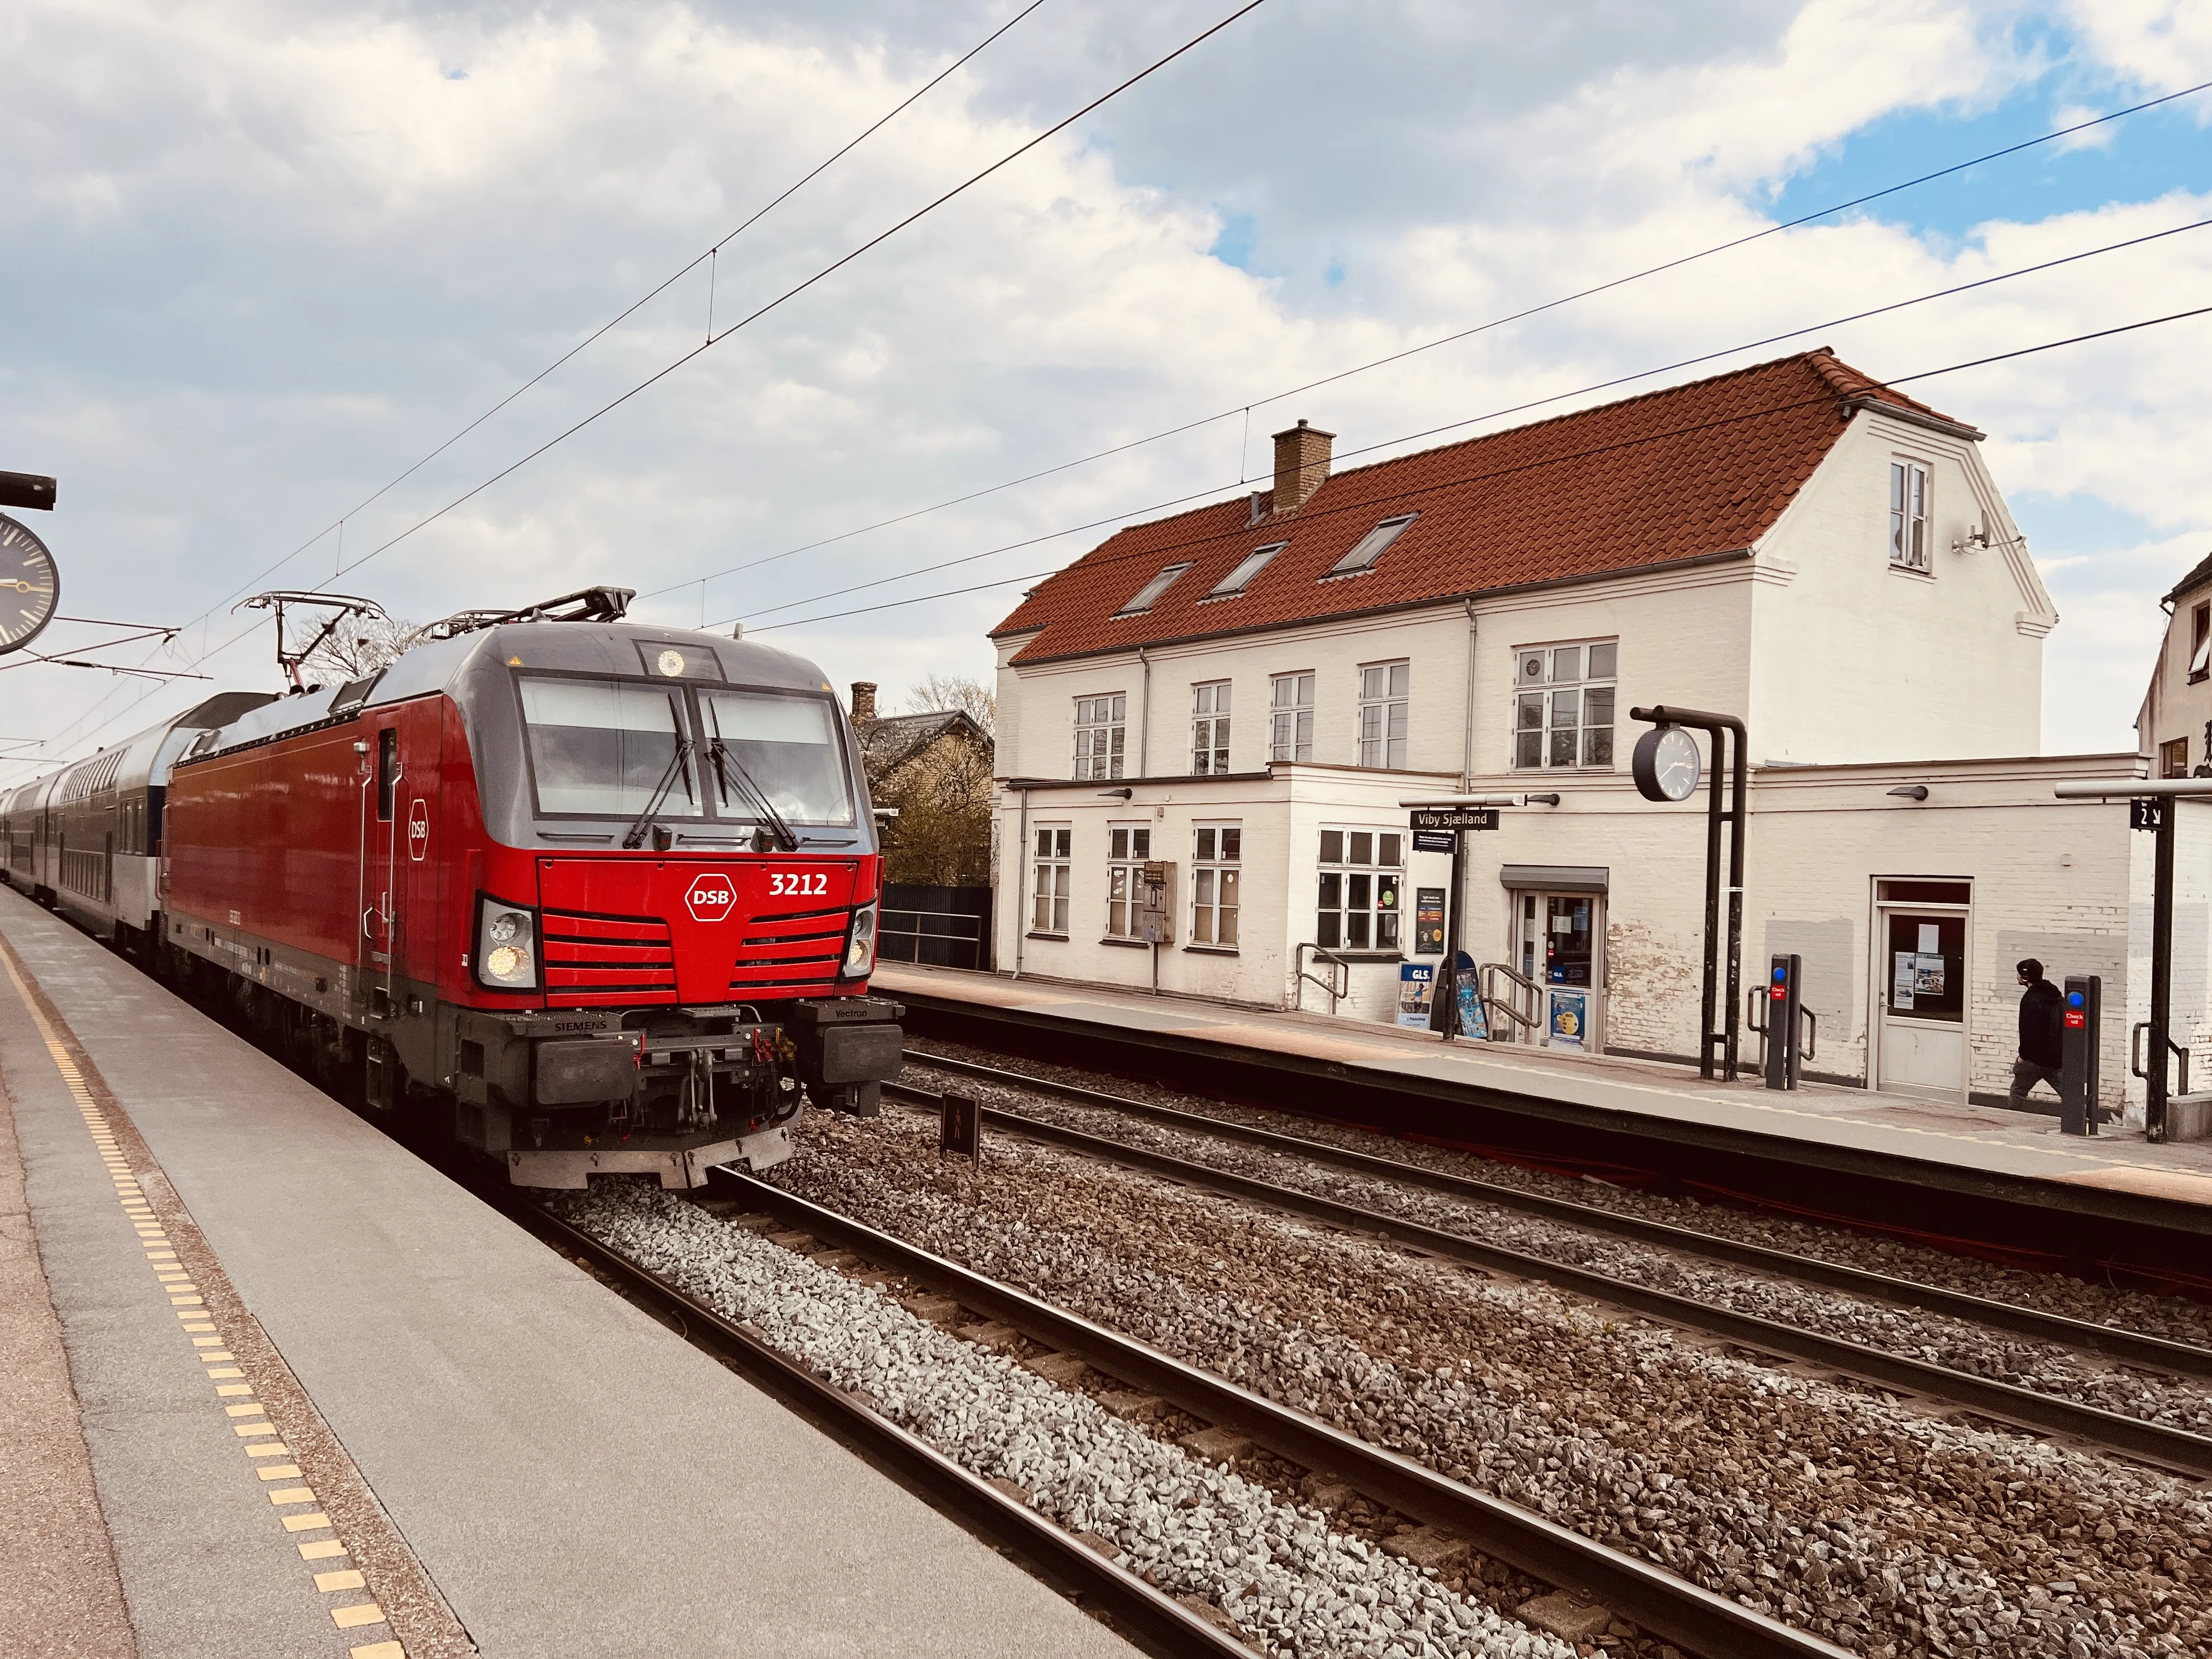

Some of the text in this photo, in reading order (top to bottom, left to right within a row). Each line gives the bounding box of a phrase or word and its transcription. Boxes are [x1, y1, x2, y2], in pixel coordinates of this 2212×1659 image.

[1418, 813, 1487, 827] Viby Sjælland
[2141, 808, 2147, 825] 2
[411, 821, 425, 838] DSB
[769, 873, 827, 895] 3212
[693, 890, 729, 904] DSB
[555, 1021, 606, 1031] SIEMENS
